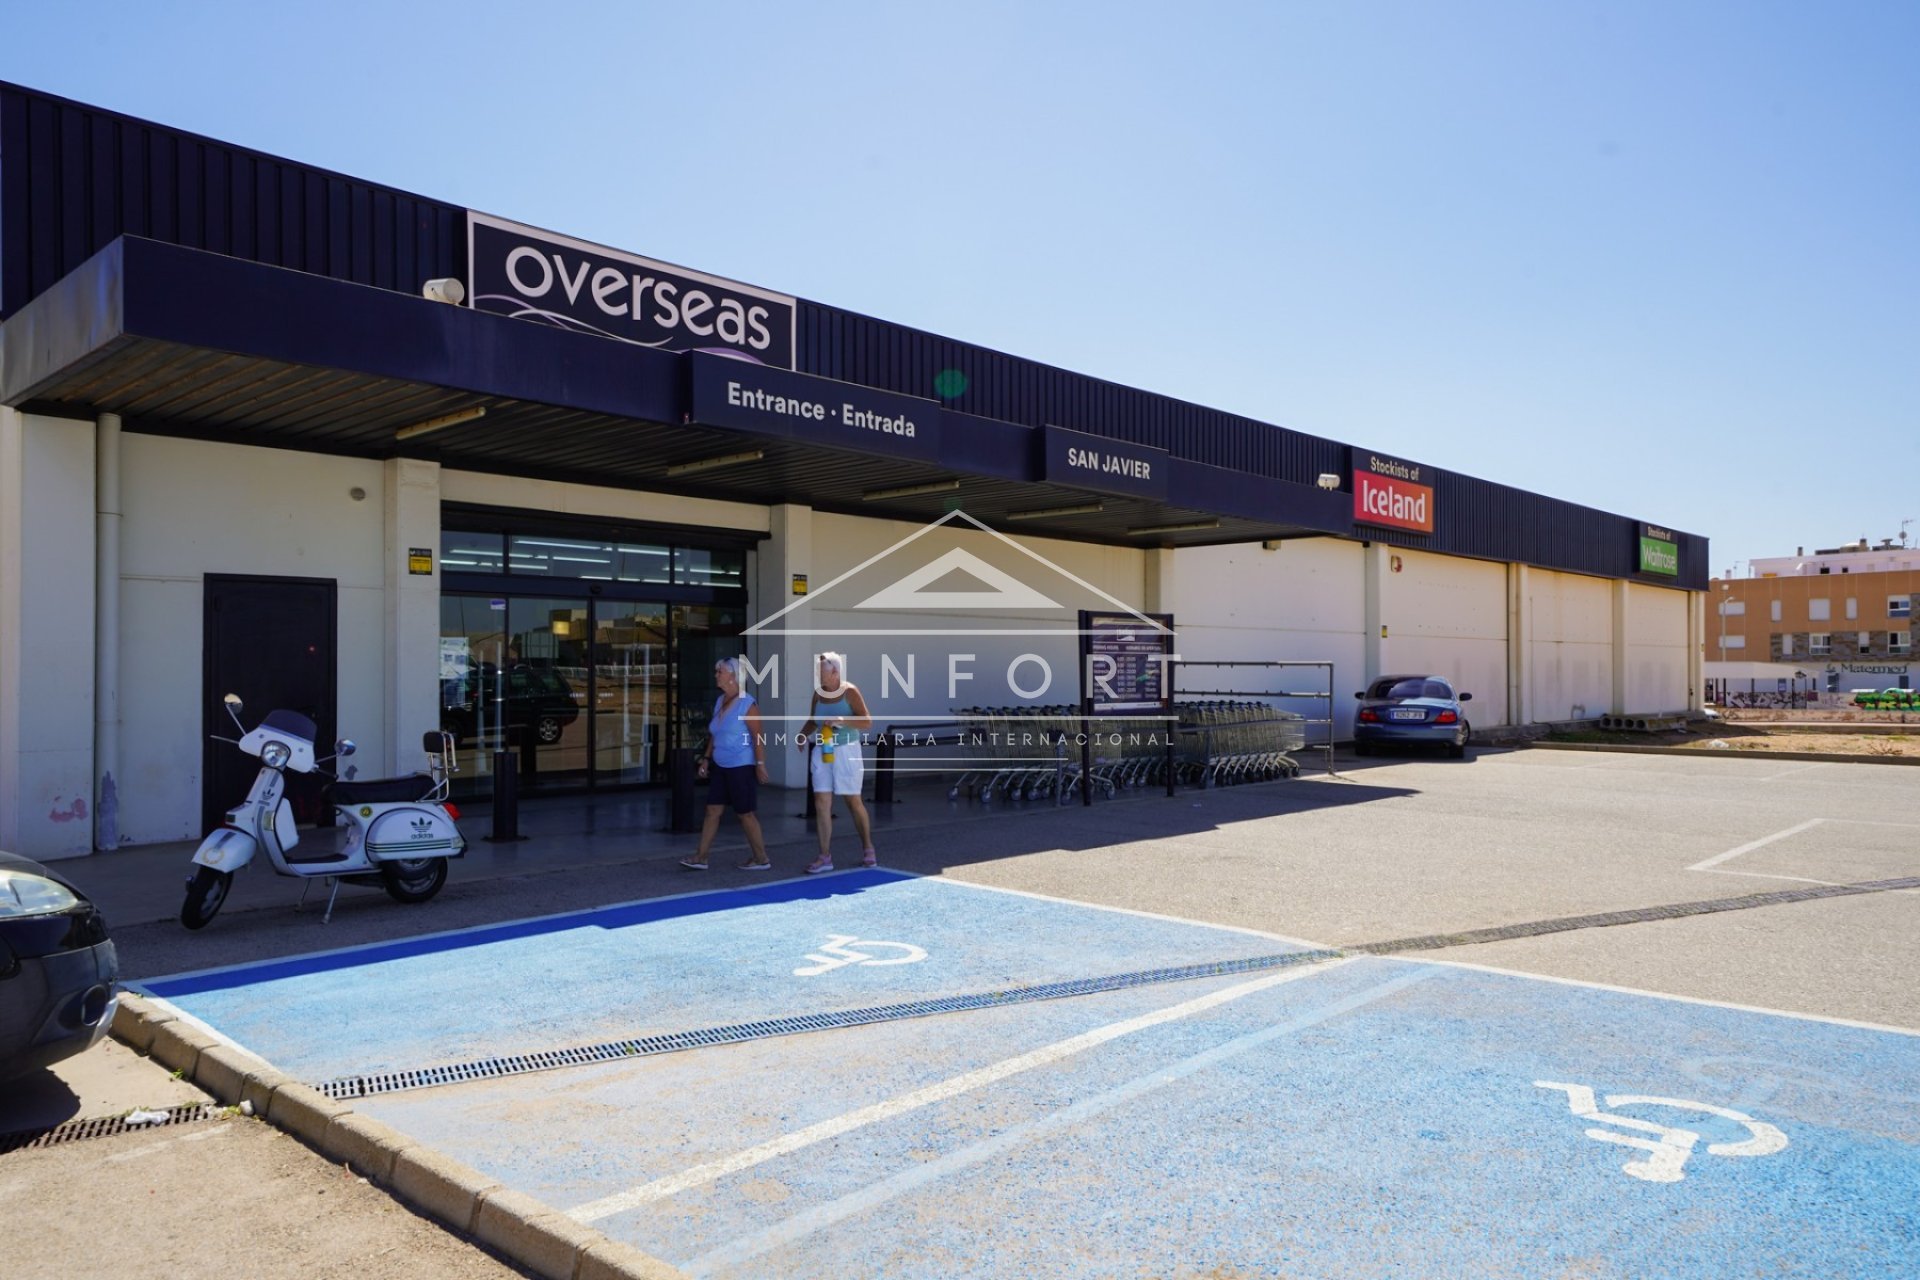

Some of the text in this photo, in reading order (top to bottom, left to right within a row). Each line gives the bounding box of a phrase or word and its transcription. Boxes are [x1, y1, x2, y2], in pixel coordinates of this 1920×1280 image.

[727, 381, 915, 438] Entrance Entrada
[1068, 447, 1151, 480] SAN JAVIER
[1370, 455, 1420, 481] Stockists of
[1362, 479, 1426, 524] Iceland
